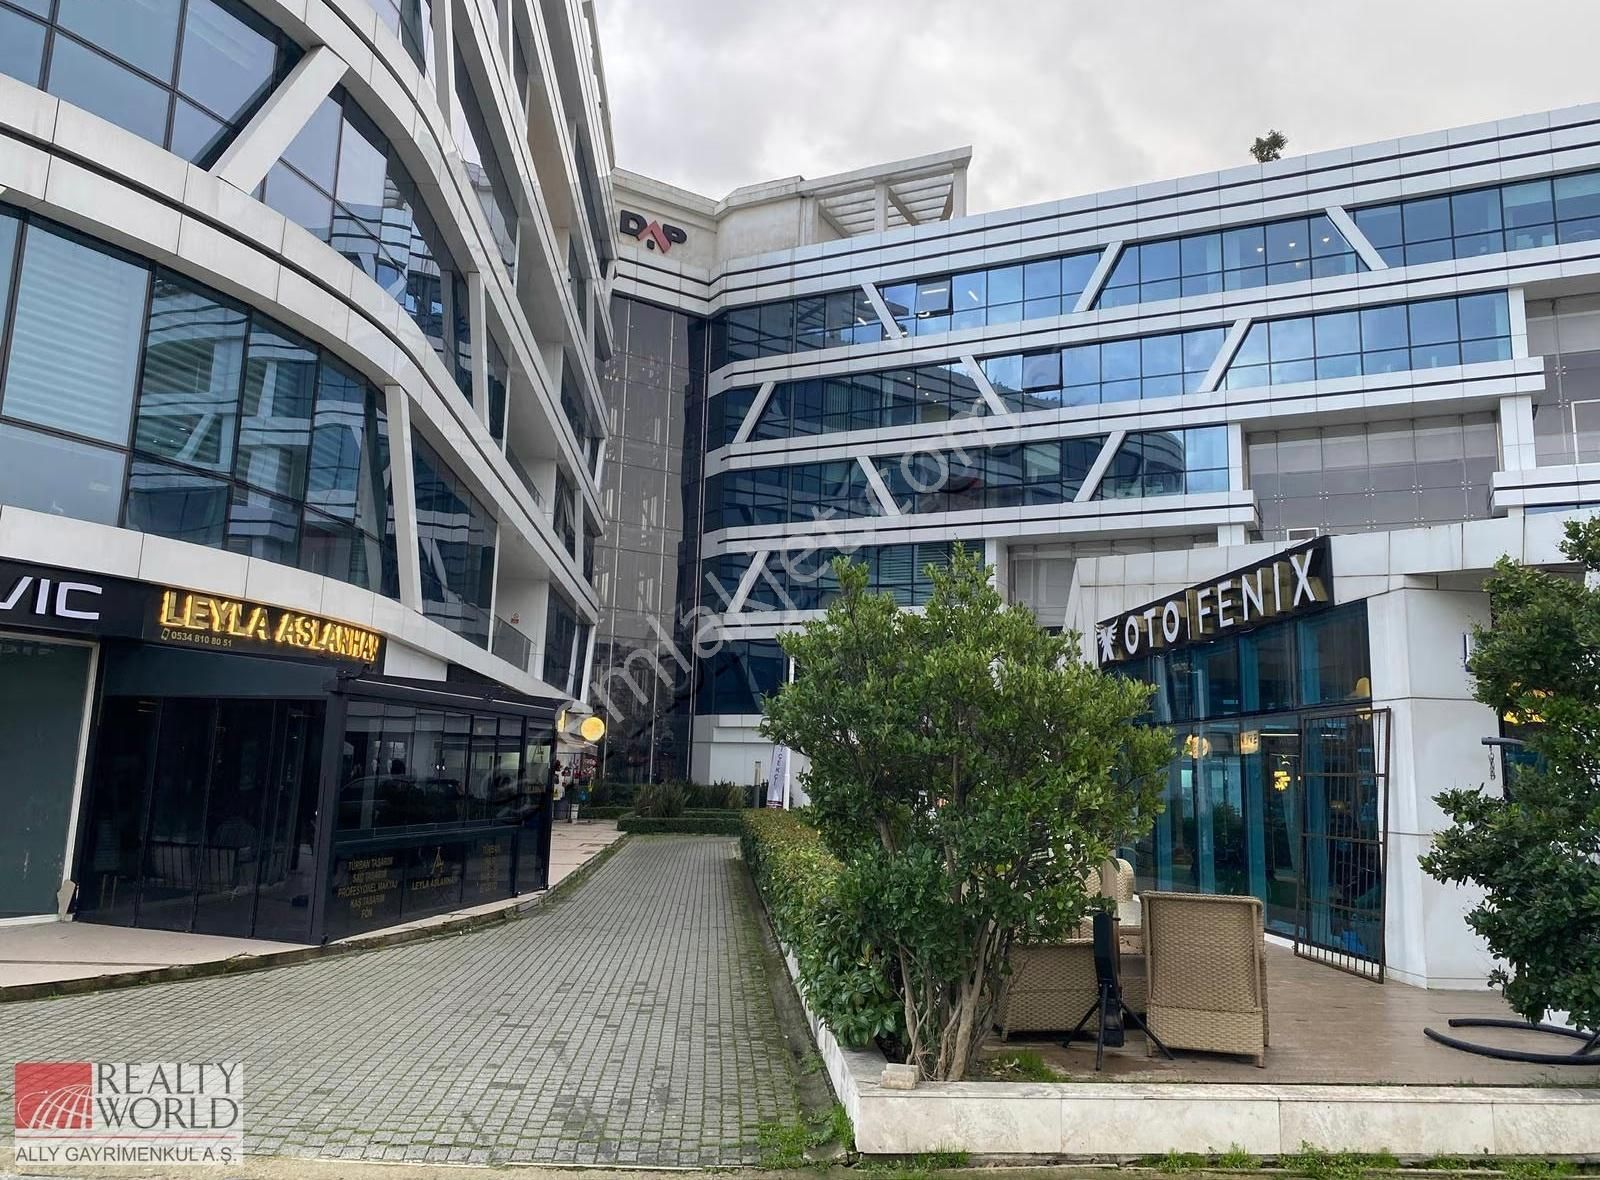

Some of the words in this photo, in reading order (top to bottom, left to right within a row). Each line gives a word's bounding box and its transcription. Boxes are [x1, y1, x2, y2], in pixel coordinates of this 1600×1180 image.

[620, 209, 688, 254] DAP
[159, 590, 271, 641] LEYLA
[1124, 600, 1180, 655] OTO
[1197, 548, 1317, 634] FENIX
[171, 631, 193, 642] 0534
[194, 634, 210, 644] 810
[211, 637, 222, 646] 80
[222, 638, 232, 648] 51
